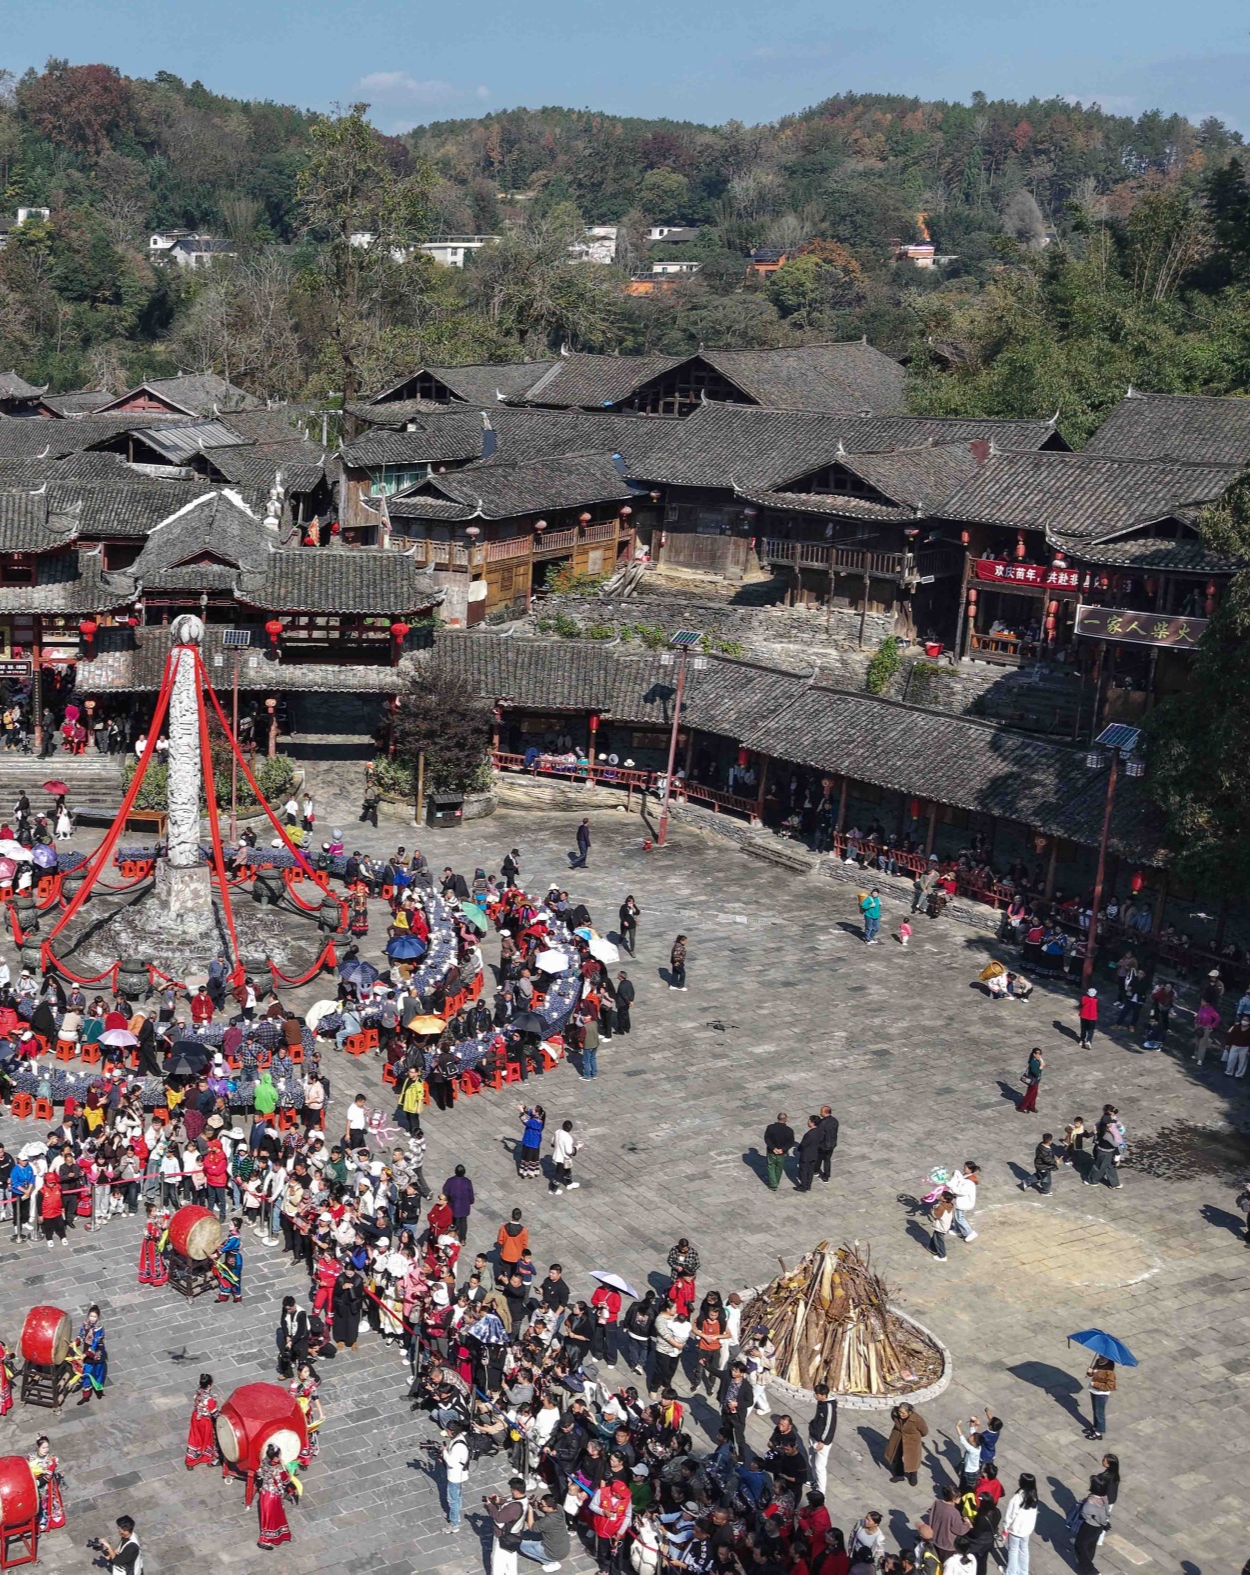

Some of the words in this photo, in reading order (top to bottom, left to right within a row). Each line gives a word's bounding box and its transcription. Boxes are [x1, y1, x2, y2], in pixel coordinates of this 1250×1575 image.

[1083, 614, 1206, 643] 一家人柴火
